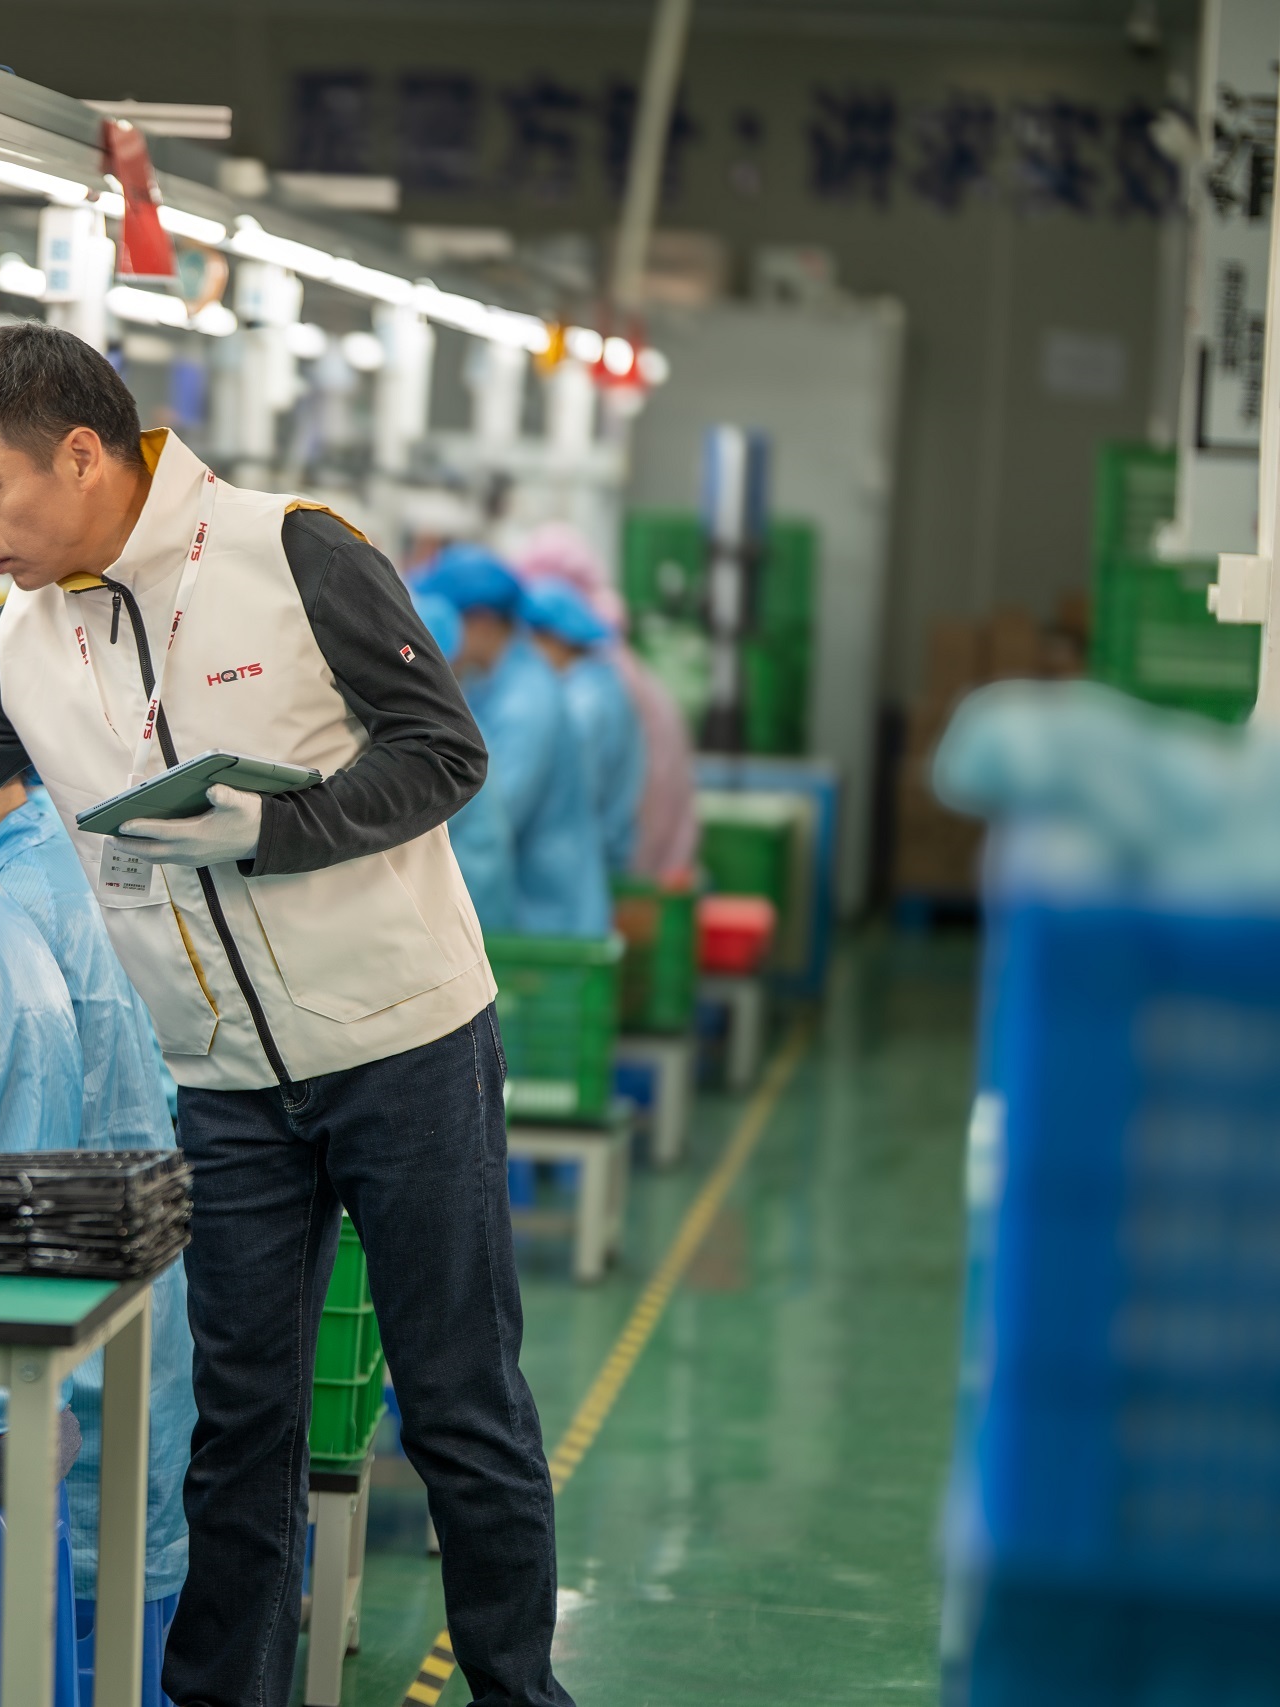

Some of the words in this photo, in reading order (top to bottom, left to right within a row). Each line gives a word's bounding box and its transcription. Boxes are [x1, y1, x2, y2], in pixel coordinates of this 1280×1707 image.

[191, 521, 208, 561] HQTS
[74, 625, 89, 665] HQTS
[206, 662, 263, 687] HQTS
[143, 699, 158, 740] HQTS
